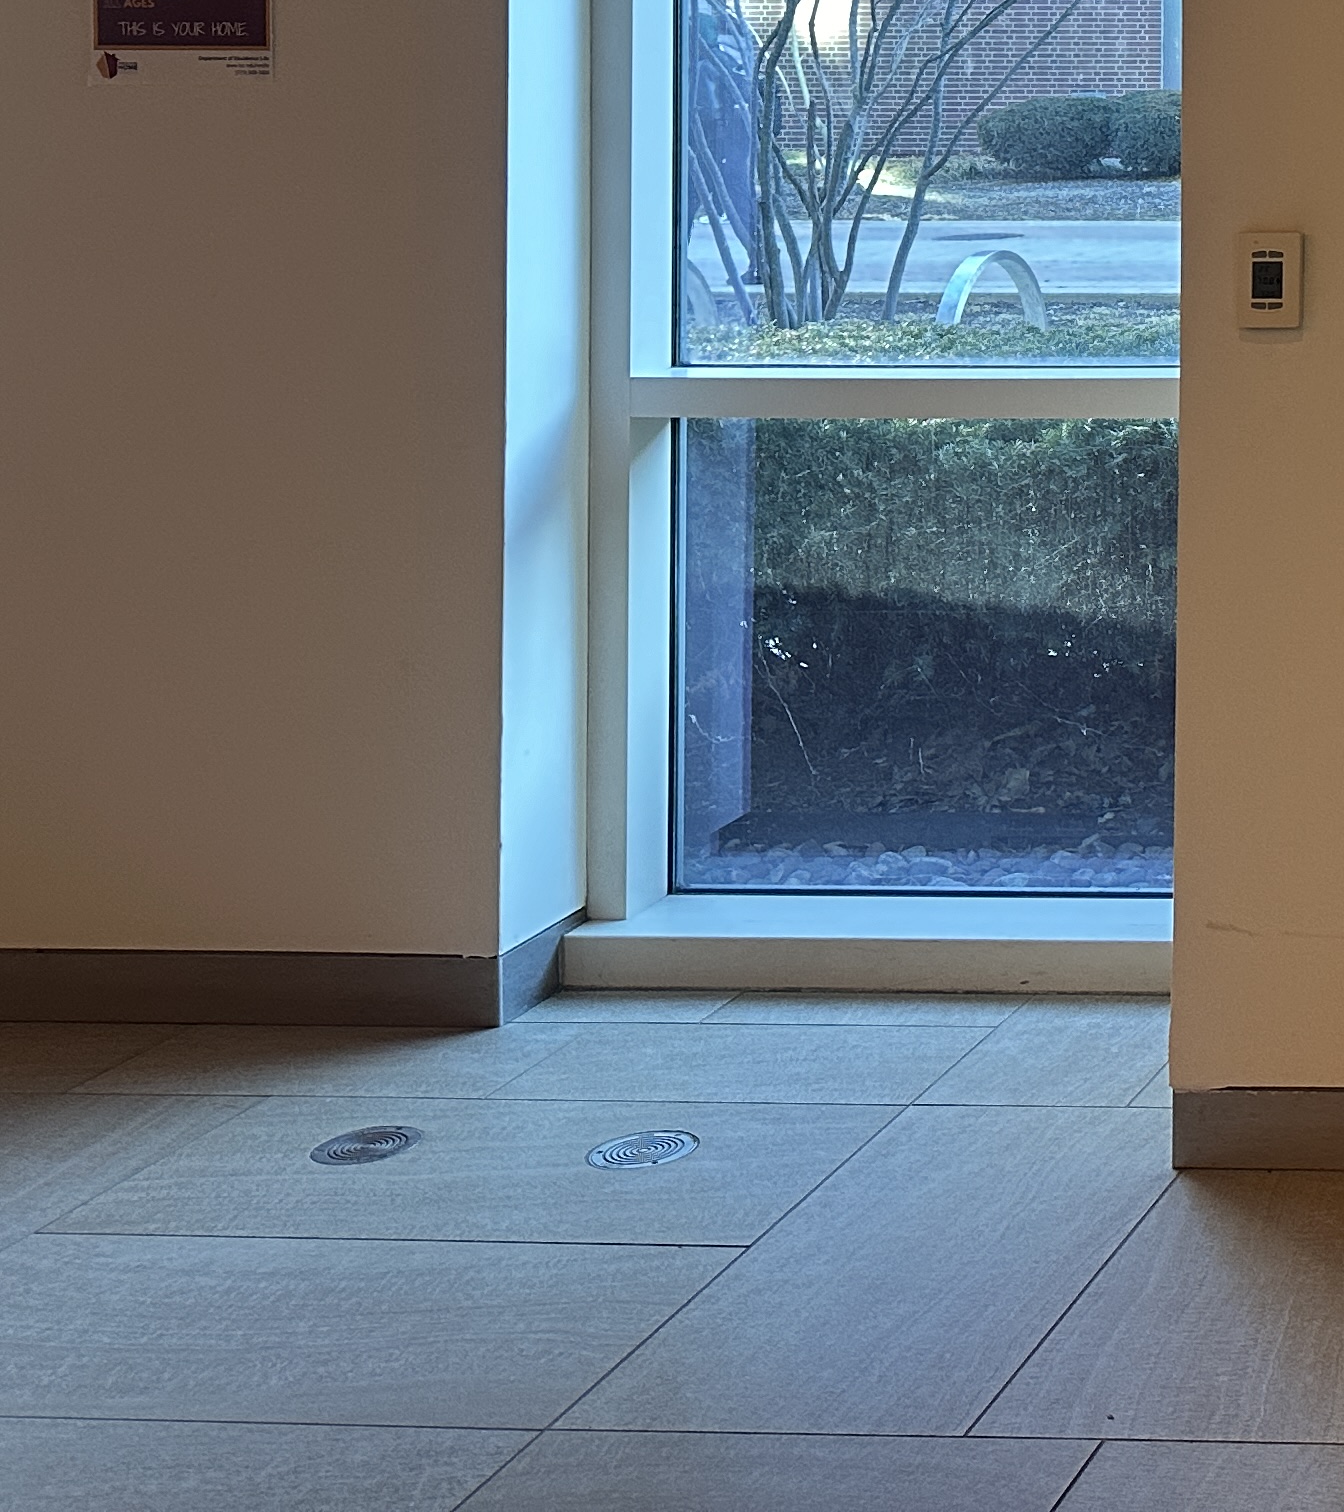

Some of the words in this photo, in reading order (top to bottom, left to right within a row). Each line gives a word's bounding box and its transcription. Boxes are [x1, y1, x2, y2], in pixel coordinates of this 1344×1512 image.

[118, 21, 147, 36] THIS
[152, 21, 165, 36] IS
[172, 21, 205, 36] YOUR
